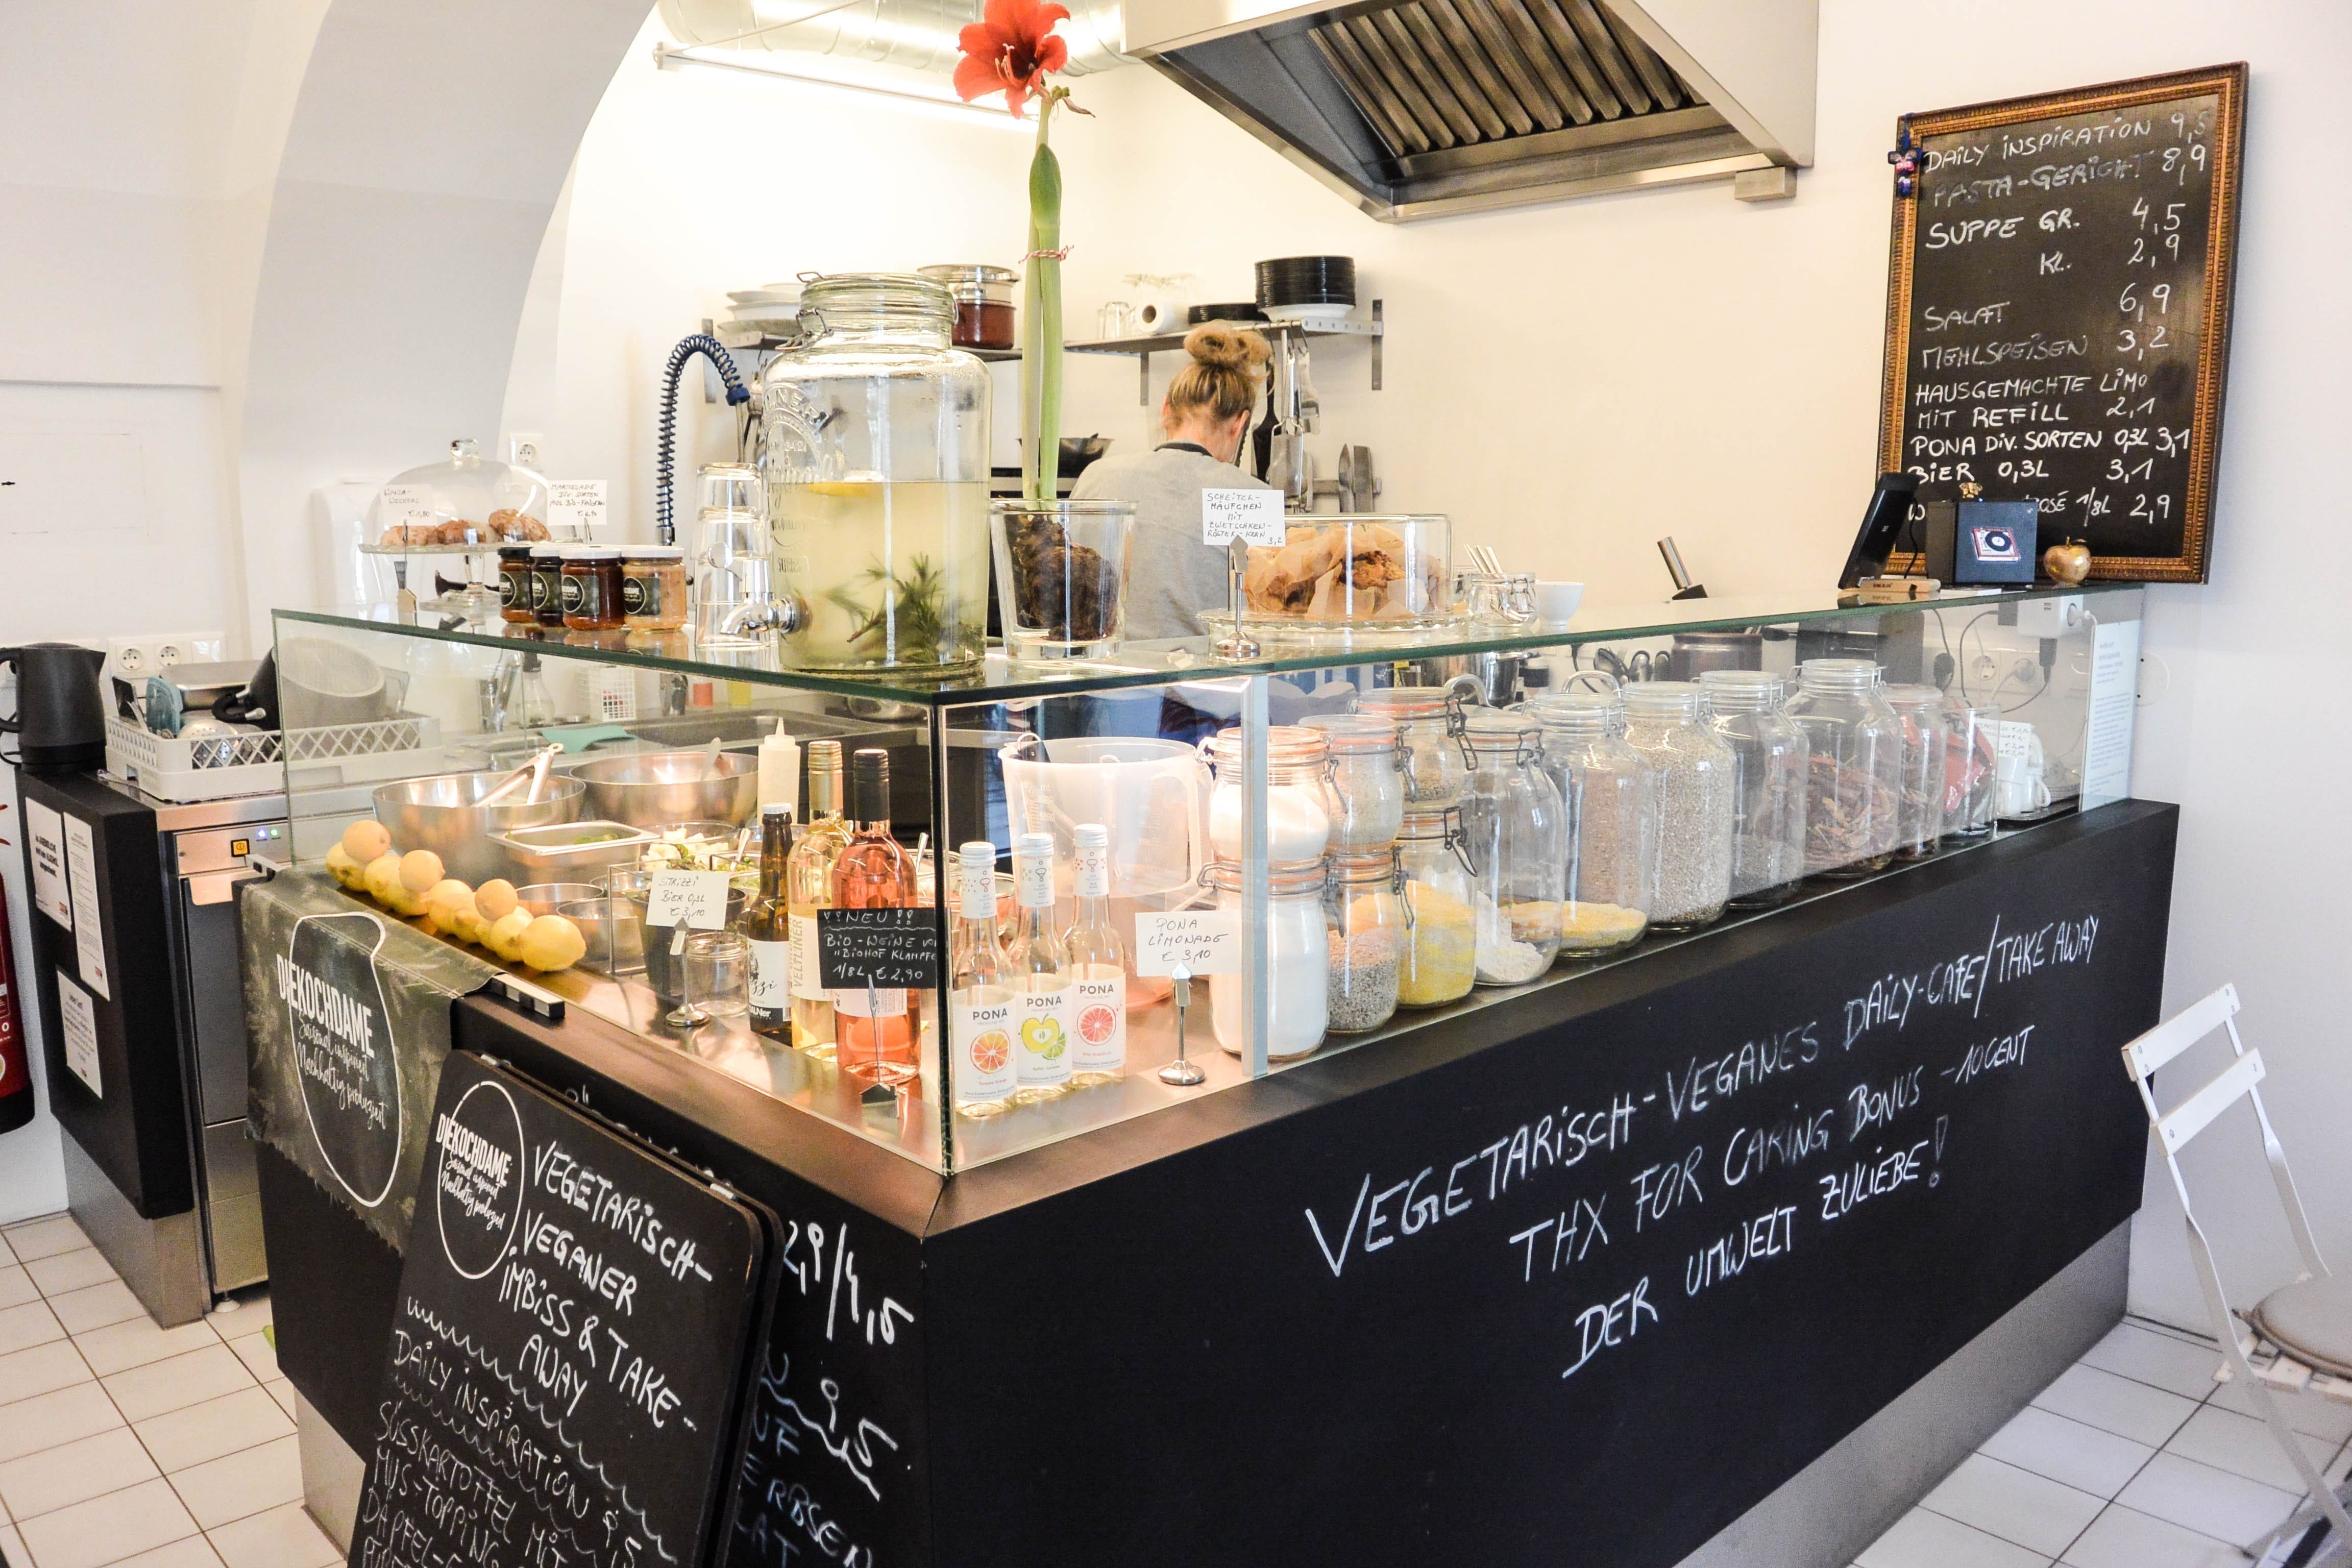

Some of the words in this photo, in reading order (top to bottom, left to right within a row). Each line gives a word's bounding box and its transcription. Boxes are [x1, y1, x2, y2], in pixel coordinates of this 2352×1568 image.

[2162, 144, 2206, 186] 8,9
[1925, 216, 2024, 250] SUPPE
[2039, 207, 2080, 233] GR.
[2132, 197, 2186, 235] 4,5
[2039, 252, 2072, 276] KL.
[2127, 234, 2180, 267] 2,9
[1924, 301, 2011, 332] SALAT
[2120, 283, 2171, 323] 6,9
[2117, 326, 2170, 360] 3,2
[1916, 375, 2092, 407] HAUSGEMACHTE
[2106, 396, 2155, 419] 2,1
[1909, 434, 1976, 457] PONA
[2023, 430, 2102, 450] SORTEN
[2155, 427, 2192, 458] 3,1
[1998, 460, 2049, 483] 0,3L
[2106, 458, 2154, 483] 3,1
[2129, 494, 2170, 524] 2,9
[1267, 537, 1283, 546] 3,2
[681, 906, 705, 921] 3,10
[1156, 918, 1197, 933] PONA
[1182, 949, 1211, 964] 3,10
[891, 968, 923, 983] 2,90
[1079, 984, 1114, 995] PONA
[276, 953, 375, 1059] DIEKOCHDAME
[972, 1008, 1008, 1021] PONA
[1026, 995, 1062, 1008] PONA
[435, 1113, 512, 1187] DIEKOCHDAME
[1509, 1192, 1608, 1282] THX
[1631, 1146, 1703, 1233] FOR
[1848, 1065, 1924, 1142] BONUS
[524, 1209, 638, 1315] VEGANER
[1562, 1276, 1658, 1379] DER
[1686, 1206, 1796, 1296] UMWELT
[578, 1315, 599, 1368] &
[519, 1334, 589, 1417] AWAY
